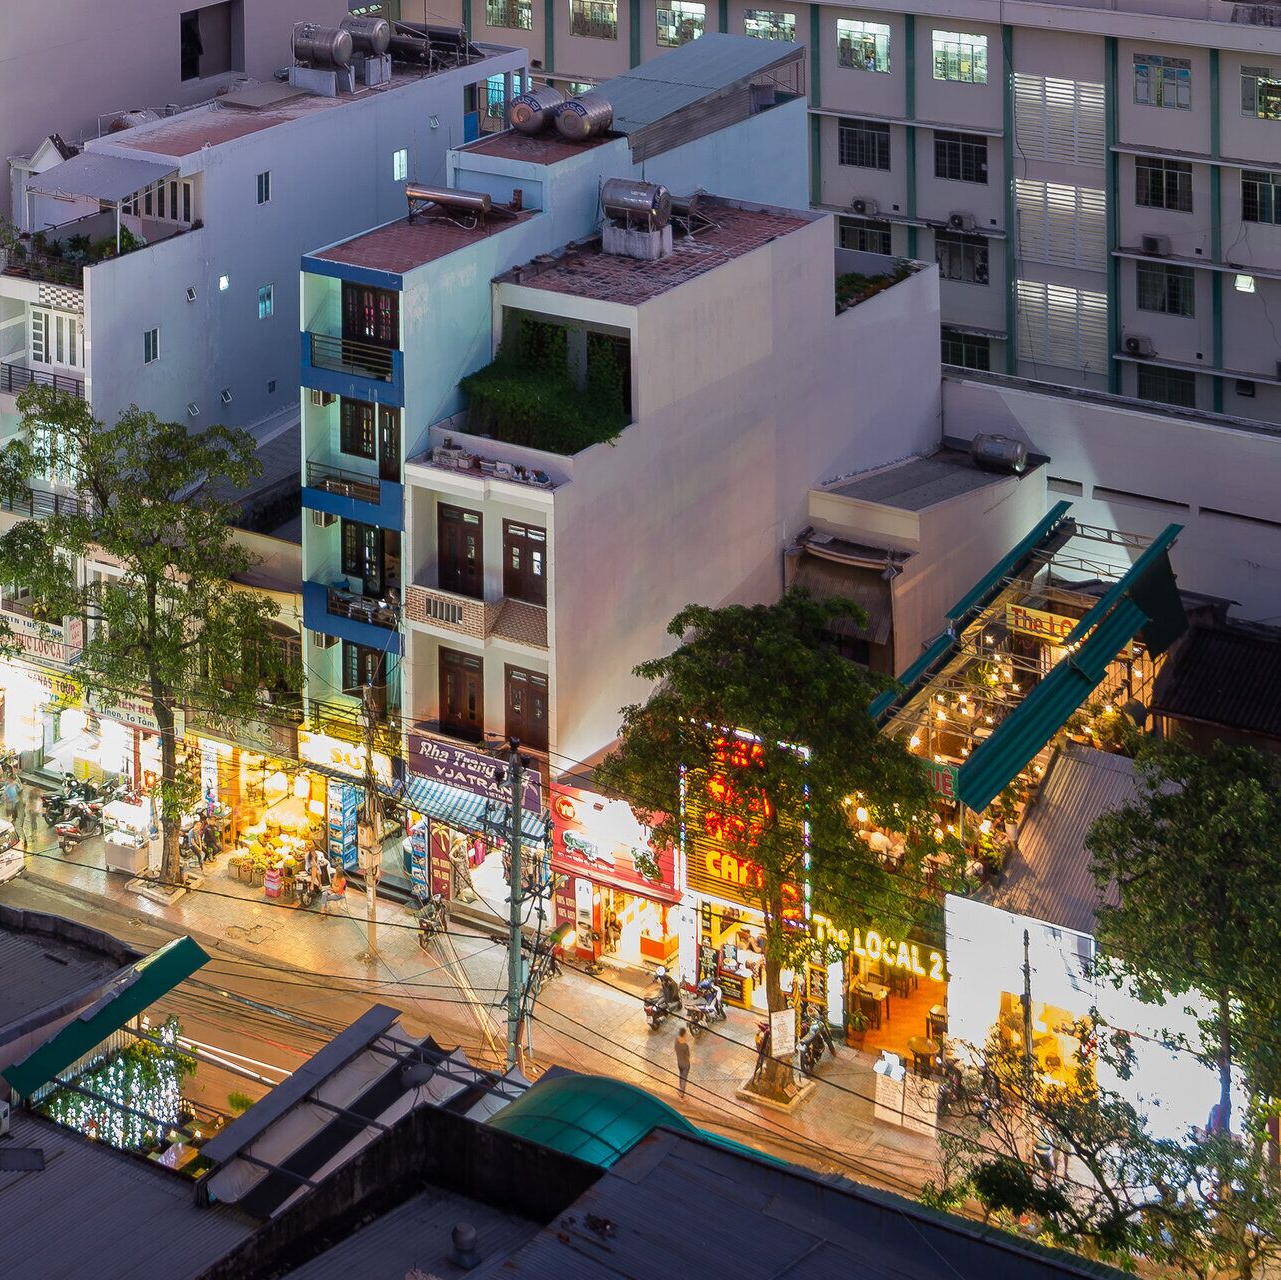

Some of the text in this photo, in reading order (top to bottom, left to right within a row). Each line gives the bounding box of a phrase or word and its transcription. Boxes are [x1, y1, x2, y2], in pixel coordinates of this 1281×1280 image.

[1011, 606, 1043, 630] The
[419, 741, 449, 763] Nha
[453, 751, 497, 779] Trang
[813, 914, 944, 982] The LOCAL 2
